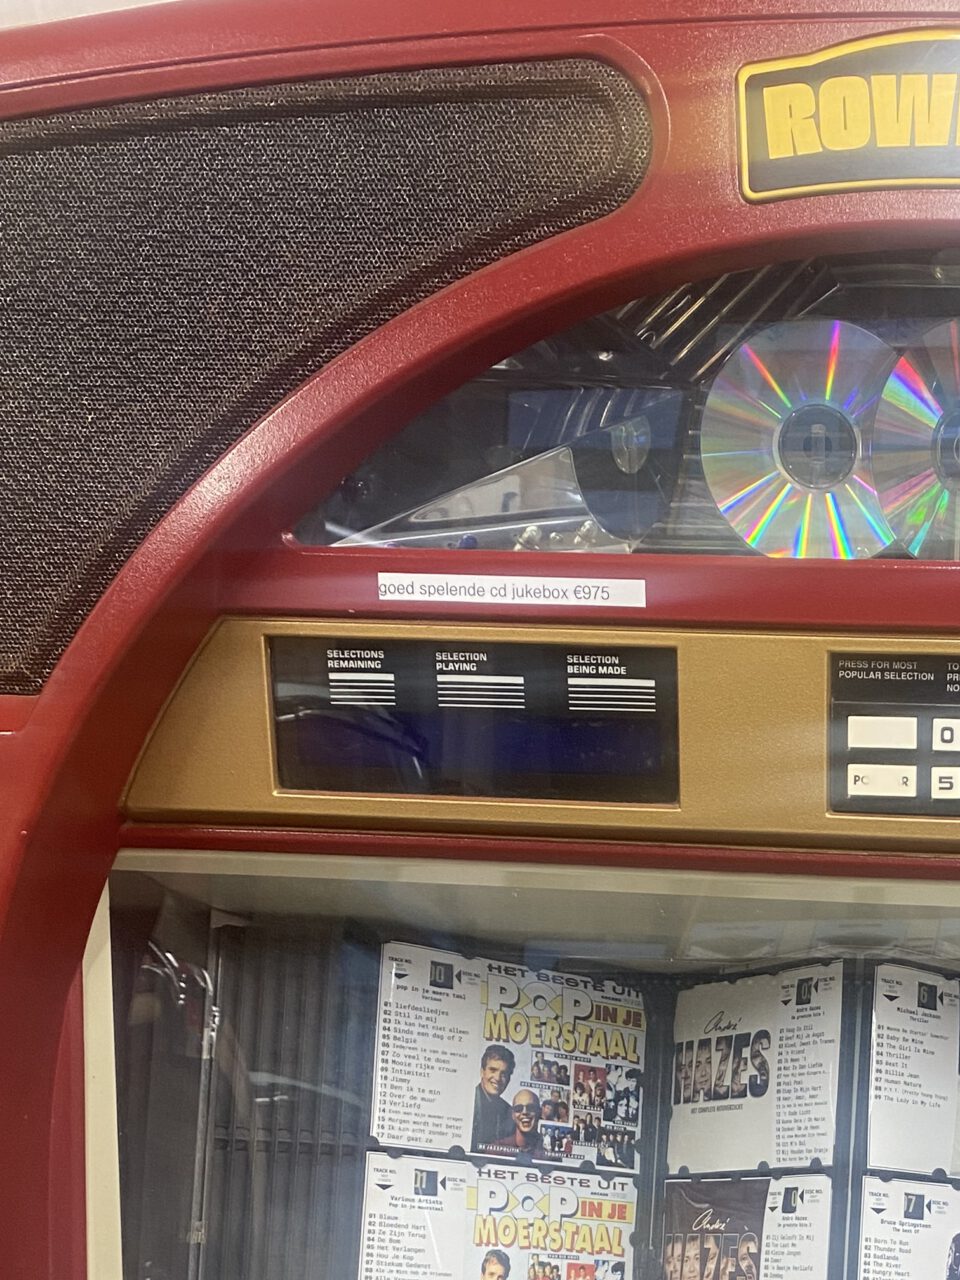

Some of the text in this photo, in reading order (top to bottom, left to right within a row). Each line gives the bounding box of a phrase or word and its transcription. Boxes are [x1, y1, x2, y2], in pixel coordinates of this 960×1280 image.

[378, 582, 610, 601] goed spelende cd jukebox €975
[327, 650, 384, 659] SELECTIONS
[435, 652, 487, 662] SELECTION
[567, 655, 619, 664] SELECTION
[327, 659, 382, 669] REMAINING
[436, 662, 477, 672] PLAYING
[567, 666, 627, 675] BEING MADE
[839, 660, 918, 669] PRESS FOR MOST
[839, 671, 934, 681] POPULAR SELECTION
[940, 726, 954, 744] 0
[939, 776, 954, 791] 5
[487, 963, 529, 978] HET
[537, 971, 605, 992] BESTE
[612, 985, 642, 999] UIT
[487, 973, 642, 1028] POP IN JE
[483, 1009, 640, 1065] MOERSTAAL
[674, 1029, 771, 1106] HAZES
[477, 1169, 629, 1191] HET BESTE UIT
[477, 1179, 627, 1229] POP IN JE
[473, 1214, 625, 1257] MOERSTAAL
